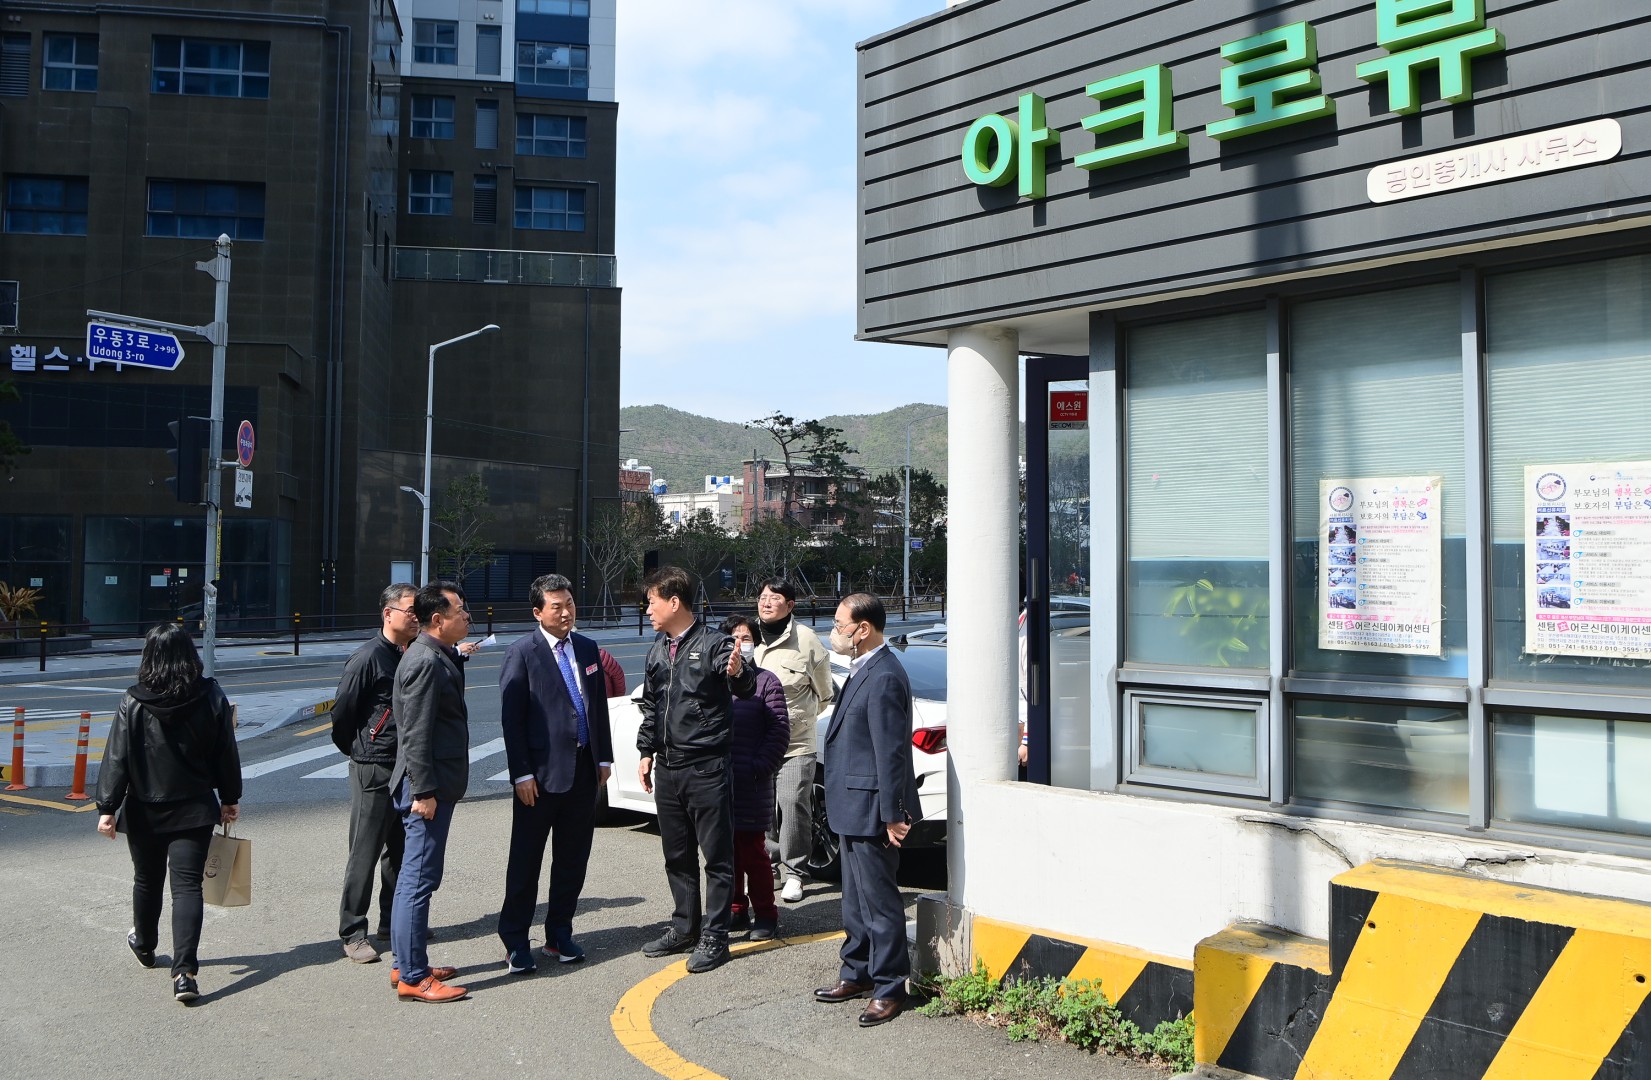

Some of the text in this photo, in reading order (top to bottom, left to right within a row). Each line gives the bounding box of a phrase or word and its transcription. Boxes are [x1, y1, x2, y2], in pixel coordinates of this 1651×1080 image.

[1386, 130, 1599, 194] 공인중개사 사무소
[93, 328, 150, 349] 우동3로
[92, 345, 145, 362] Udong 3-ro
[1056, 400, 1081, 411] 에스원
[1573, 487, 1642, 498] 부모님의 행복은
[1359, 500, 1389, 509] 부모님의
[1573, 501, 1642, 511] 보호자의 부담은
[1359, 512, 1416, 521] 보호자의 부담은
[1355, 621, 1430, 634] 어르신데이케어센터
[1537, 621, 1556, 632] 센텀
[1548, 643, 1598, 651] 051-741-6163
